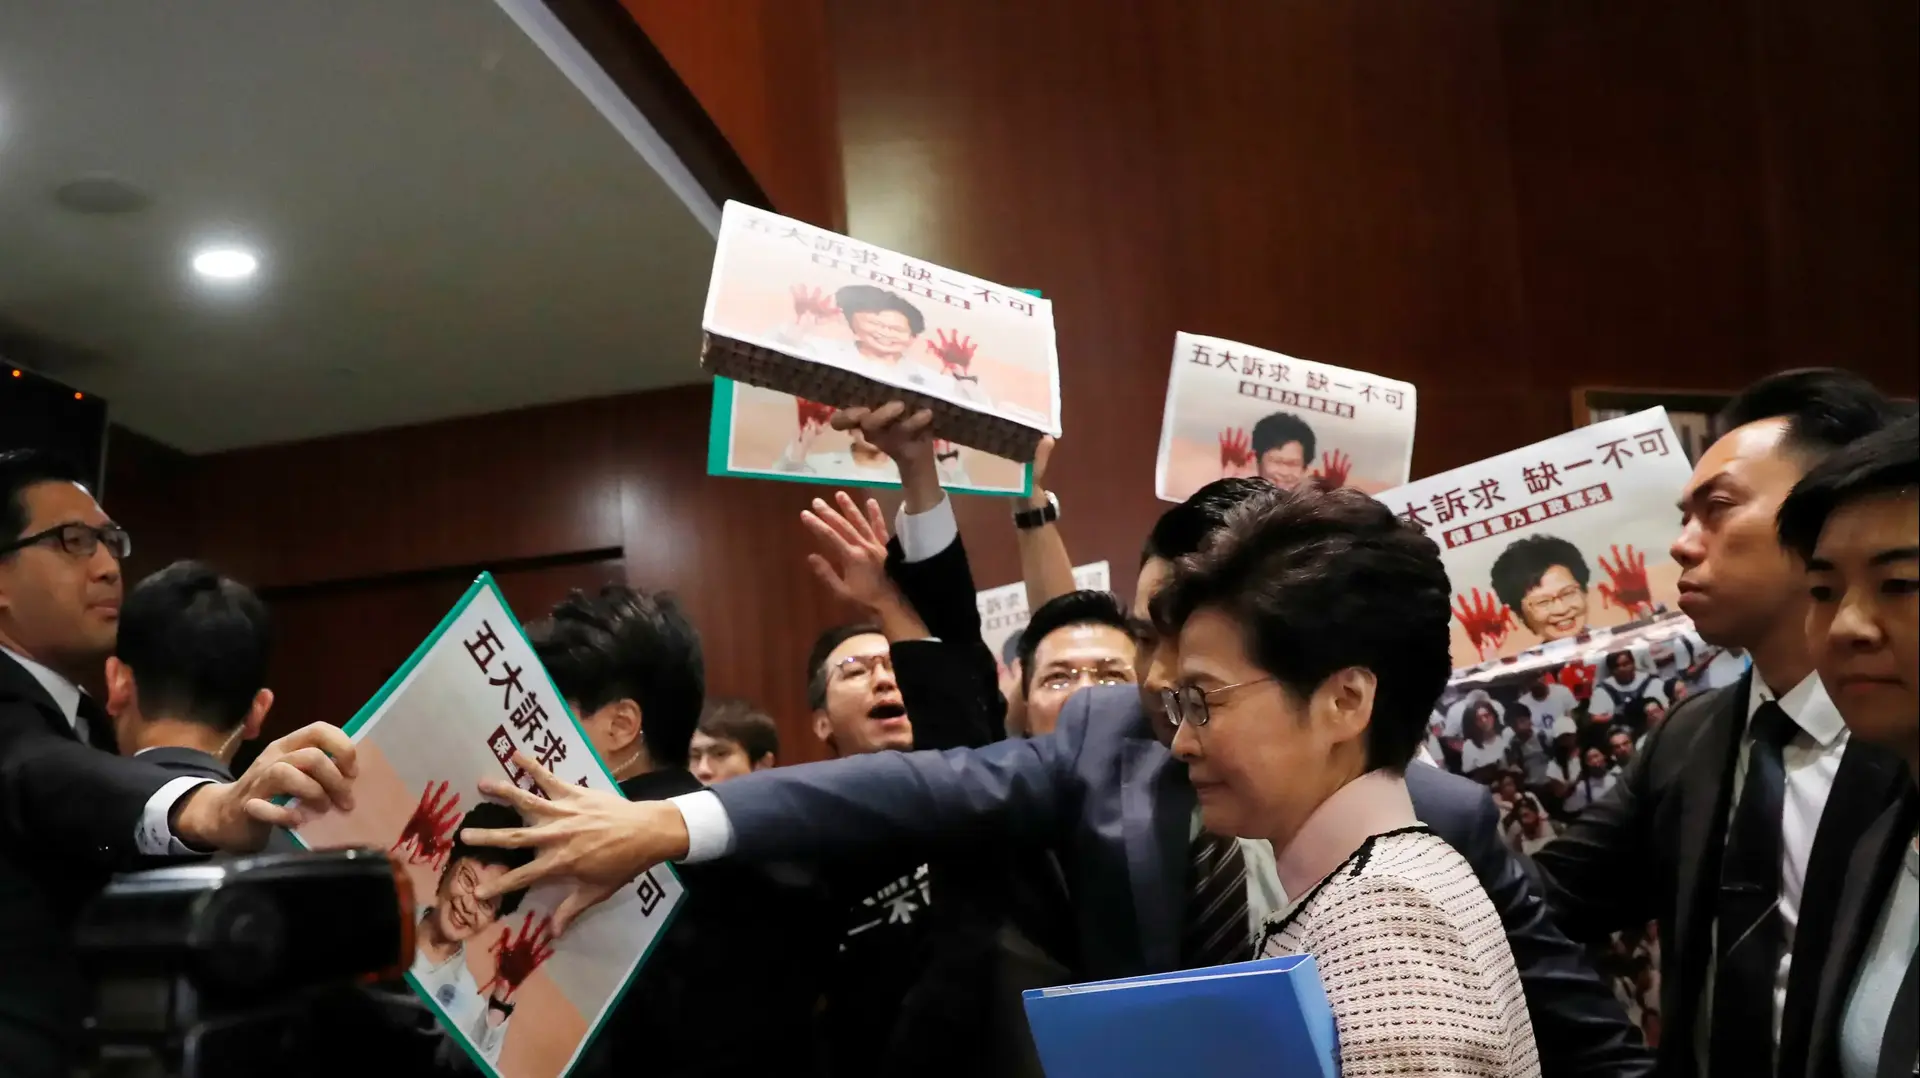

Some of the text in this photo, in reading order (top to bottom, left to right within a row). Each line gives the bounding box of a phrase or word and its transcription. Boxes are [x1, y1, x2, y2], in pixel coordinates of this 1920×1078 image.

[902, 262, 1036, 316] 缺一不可
[1189, 343, 1290, 382] 五大訴求
[1306, 370, 1404, 410] 缺一不可
[1522, 428, 1670, 495] 缺一不可
[463, 619, 567, 773] 五大訴求
